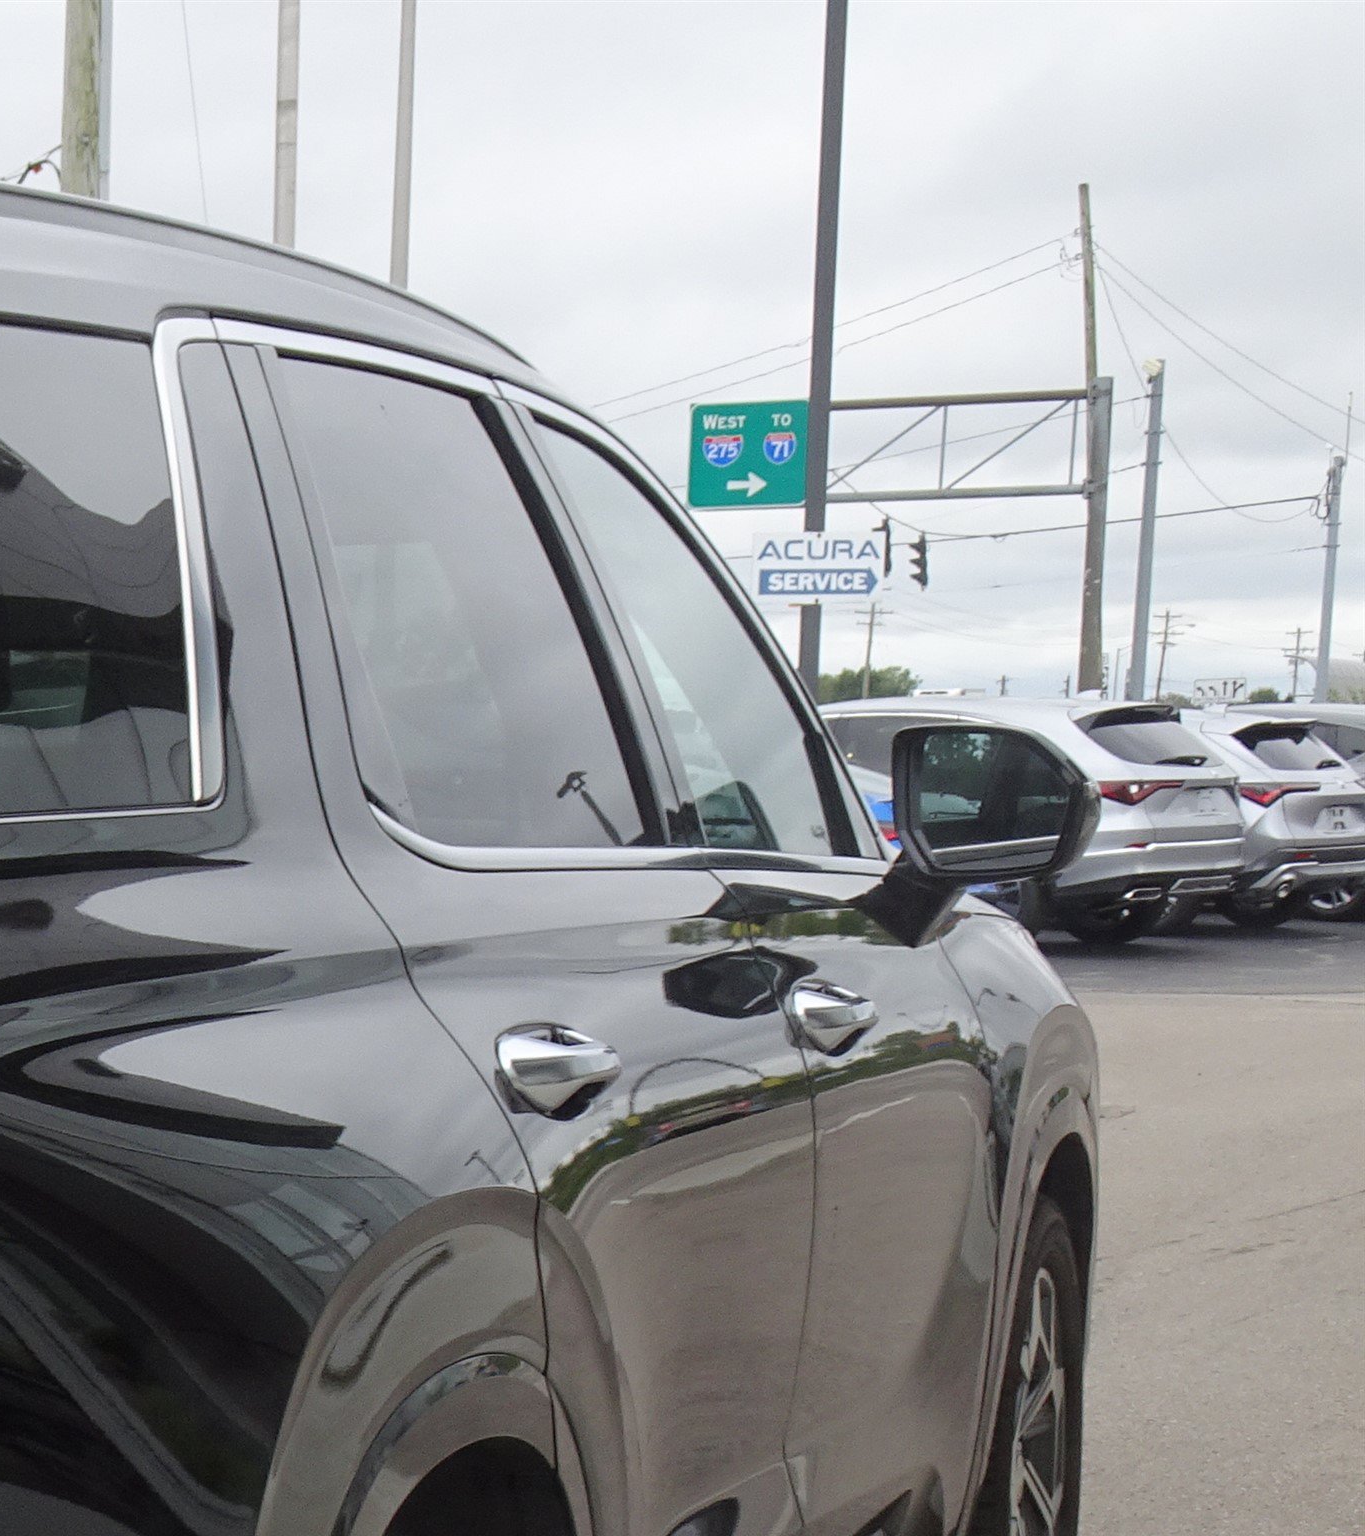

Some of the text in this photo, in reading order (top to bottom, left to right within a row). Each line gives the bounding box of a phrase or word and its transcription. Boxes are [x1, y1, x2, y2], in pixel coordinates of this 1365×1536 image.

[702, 412, 793, 430] WEST TO
[707, 440, 790, 459] 275 71
[757, 539, 880, 560] ACURA
[767, 571, 869, 591] SERVICE
